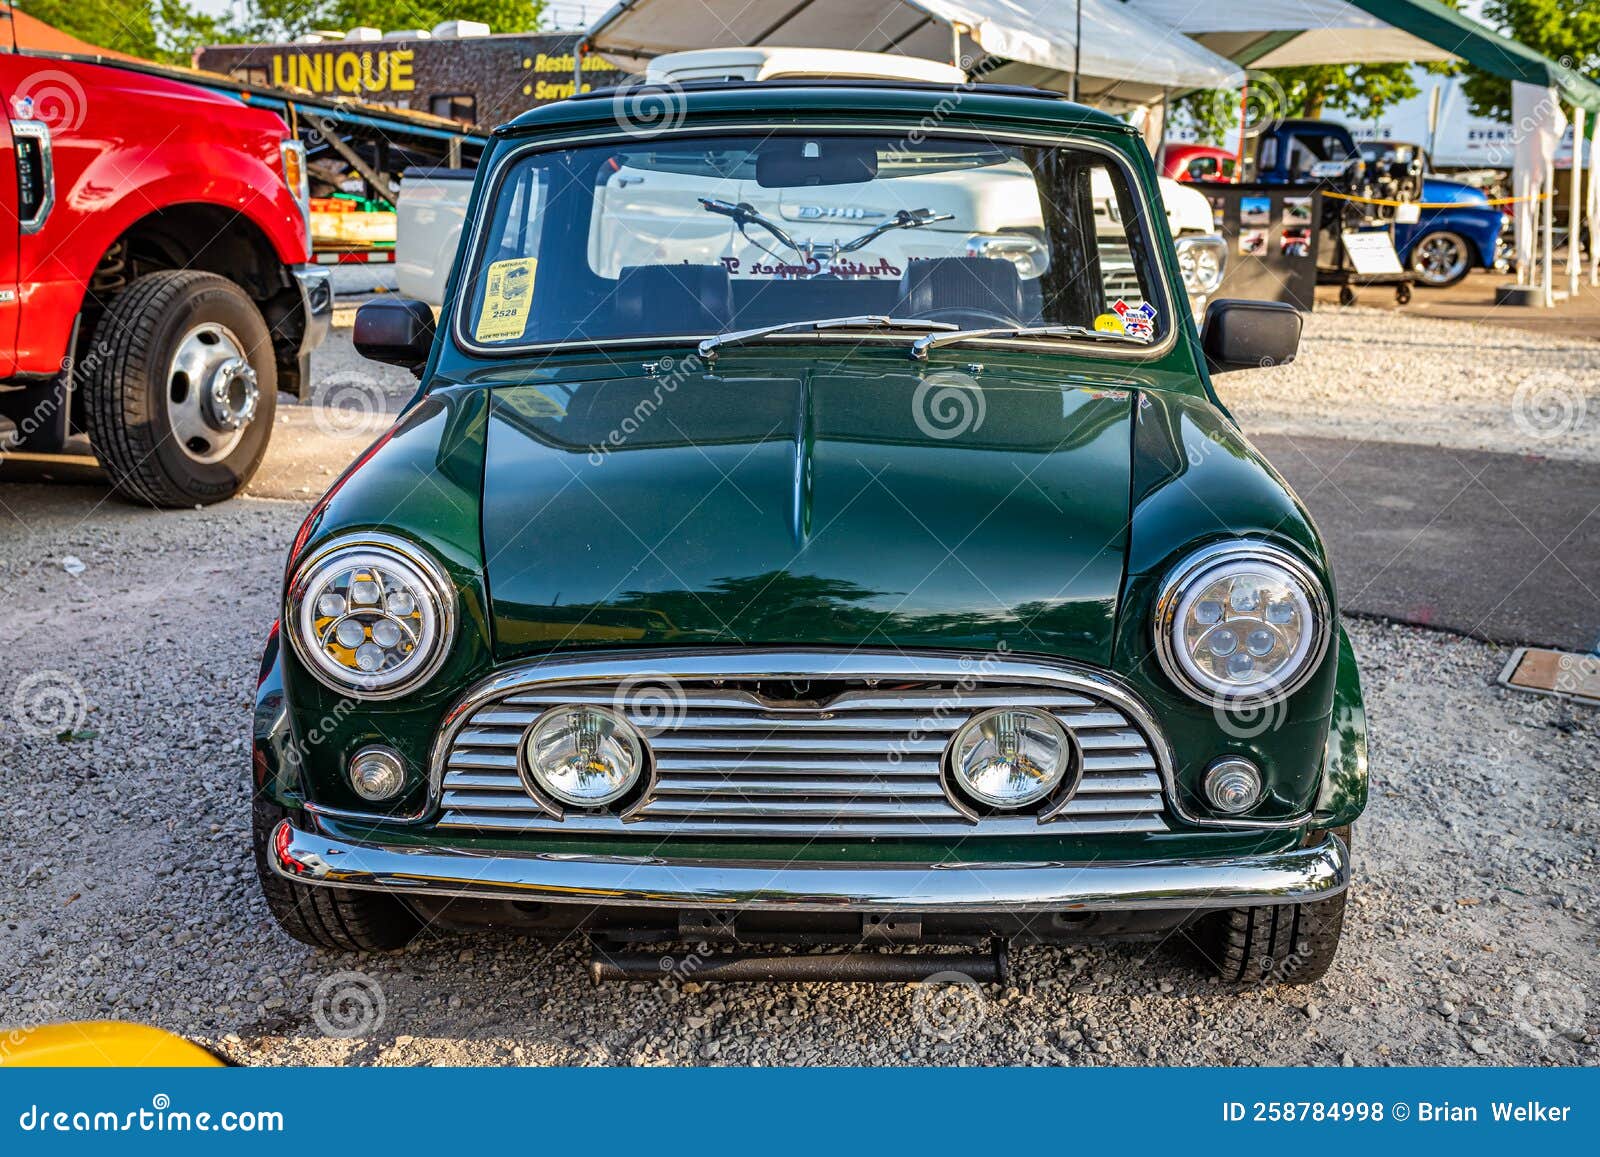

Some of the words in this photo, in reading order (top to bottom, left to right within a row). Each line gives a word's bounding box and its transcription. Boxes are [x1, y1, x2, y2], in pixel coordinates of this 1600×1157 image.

[273, 51, 415, 94] UNIQUE
[534, 81, 592, 100] Servie
[493, 309, 517, 318] 2528
